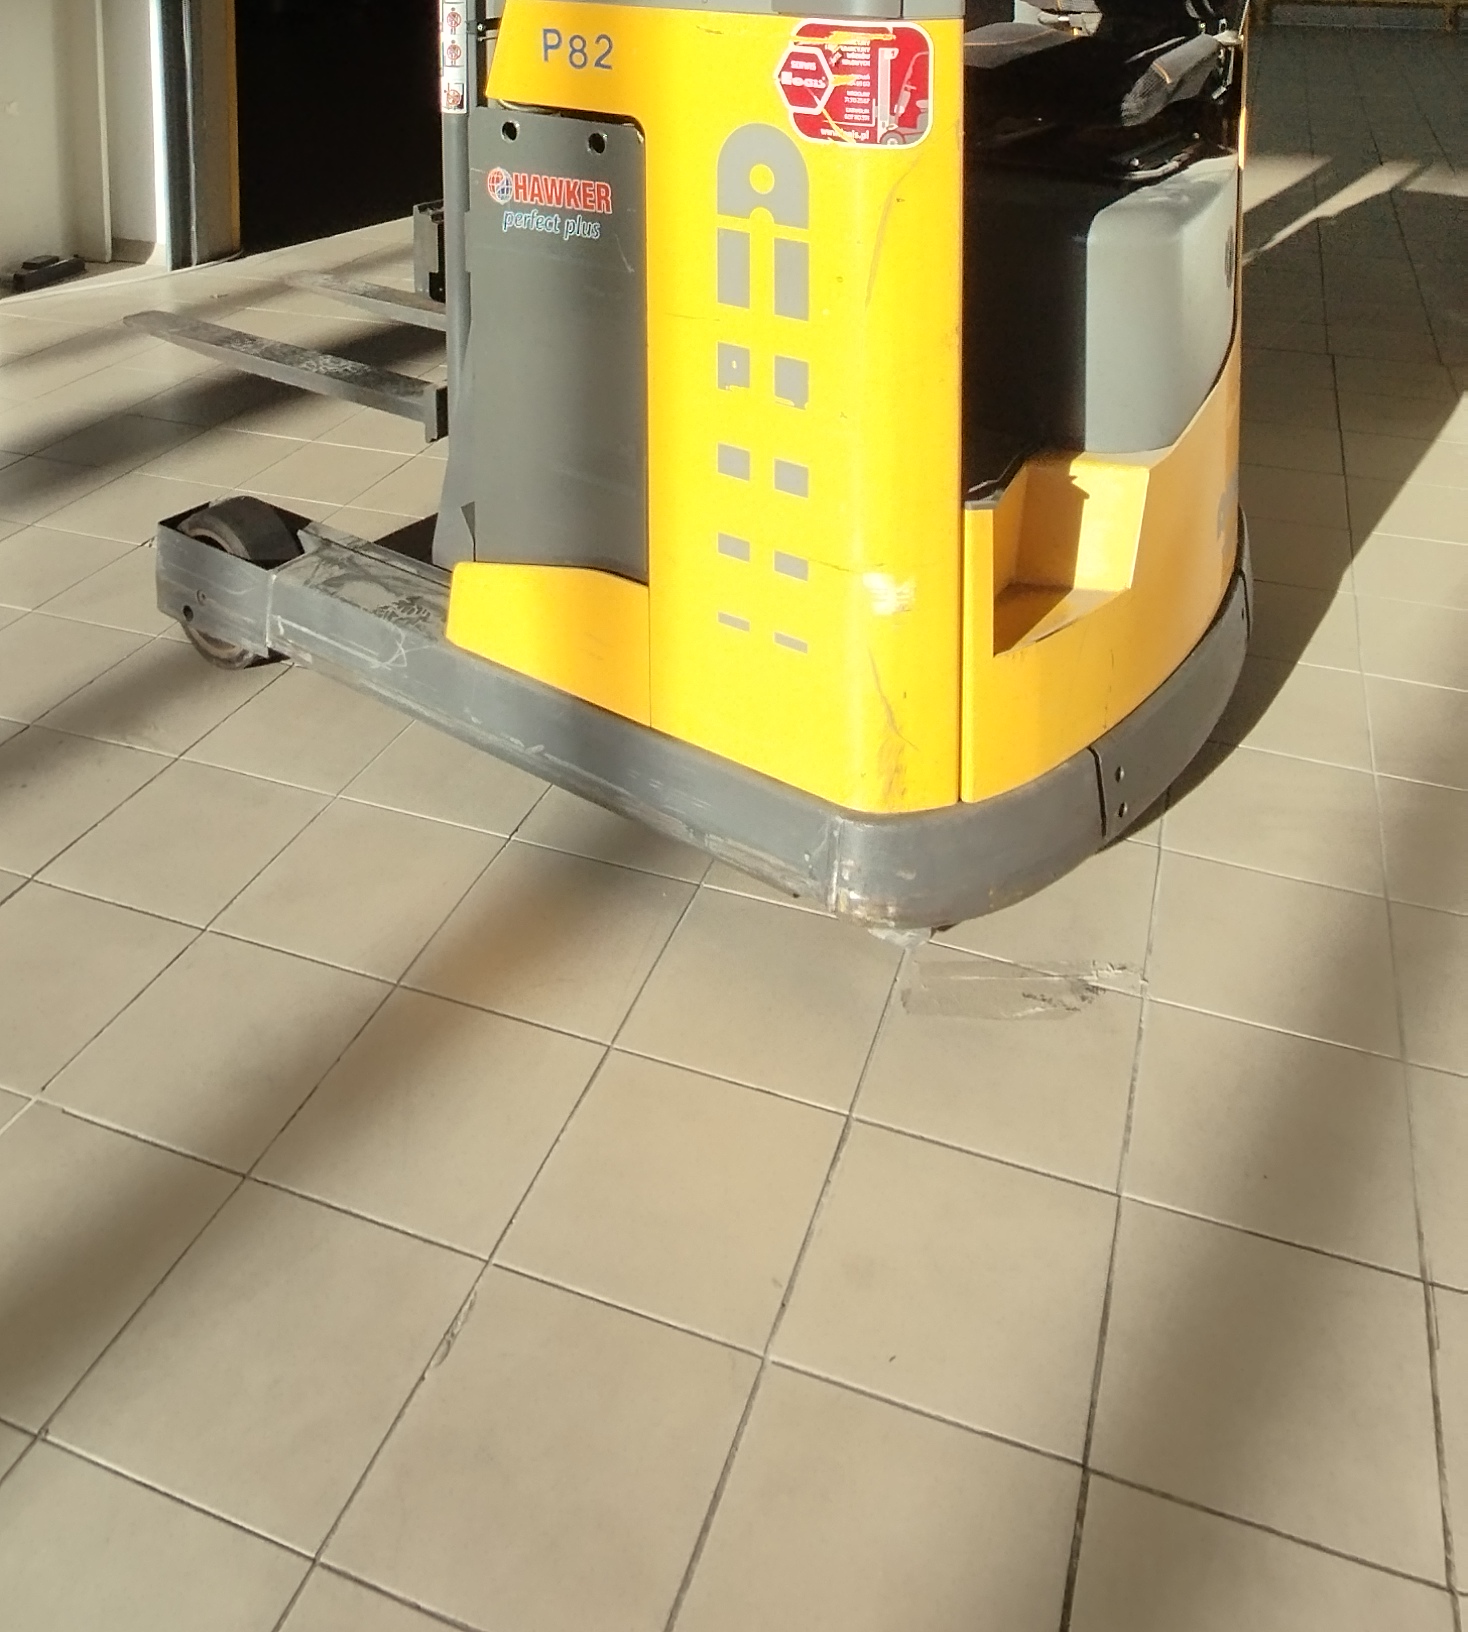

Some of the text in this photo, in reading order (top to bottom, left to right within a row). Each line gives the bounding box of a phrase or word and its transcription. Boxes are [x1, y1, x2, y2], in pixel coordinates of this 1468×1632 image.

[542, 28, 613, 70] P82
[513, 173, 613, 214] HAWKER
[503, 209, 600, 240] perfect plus
